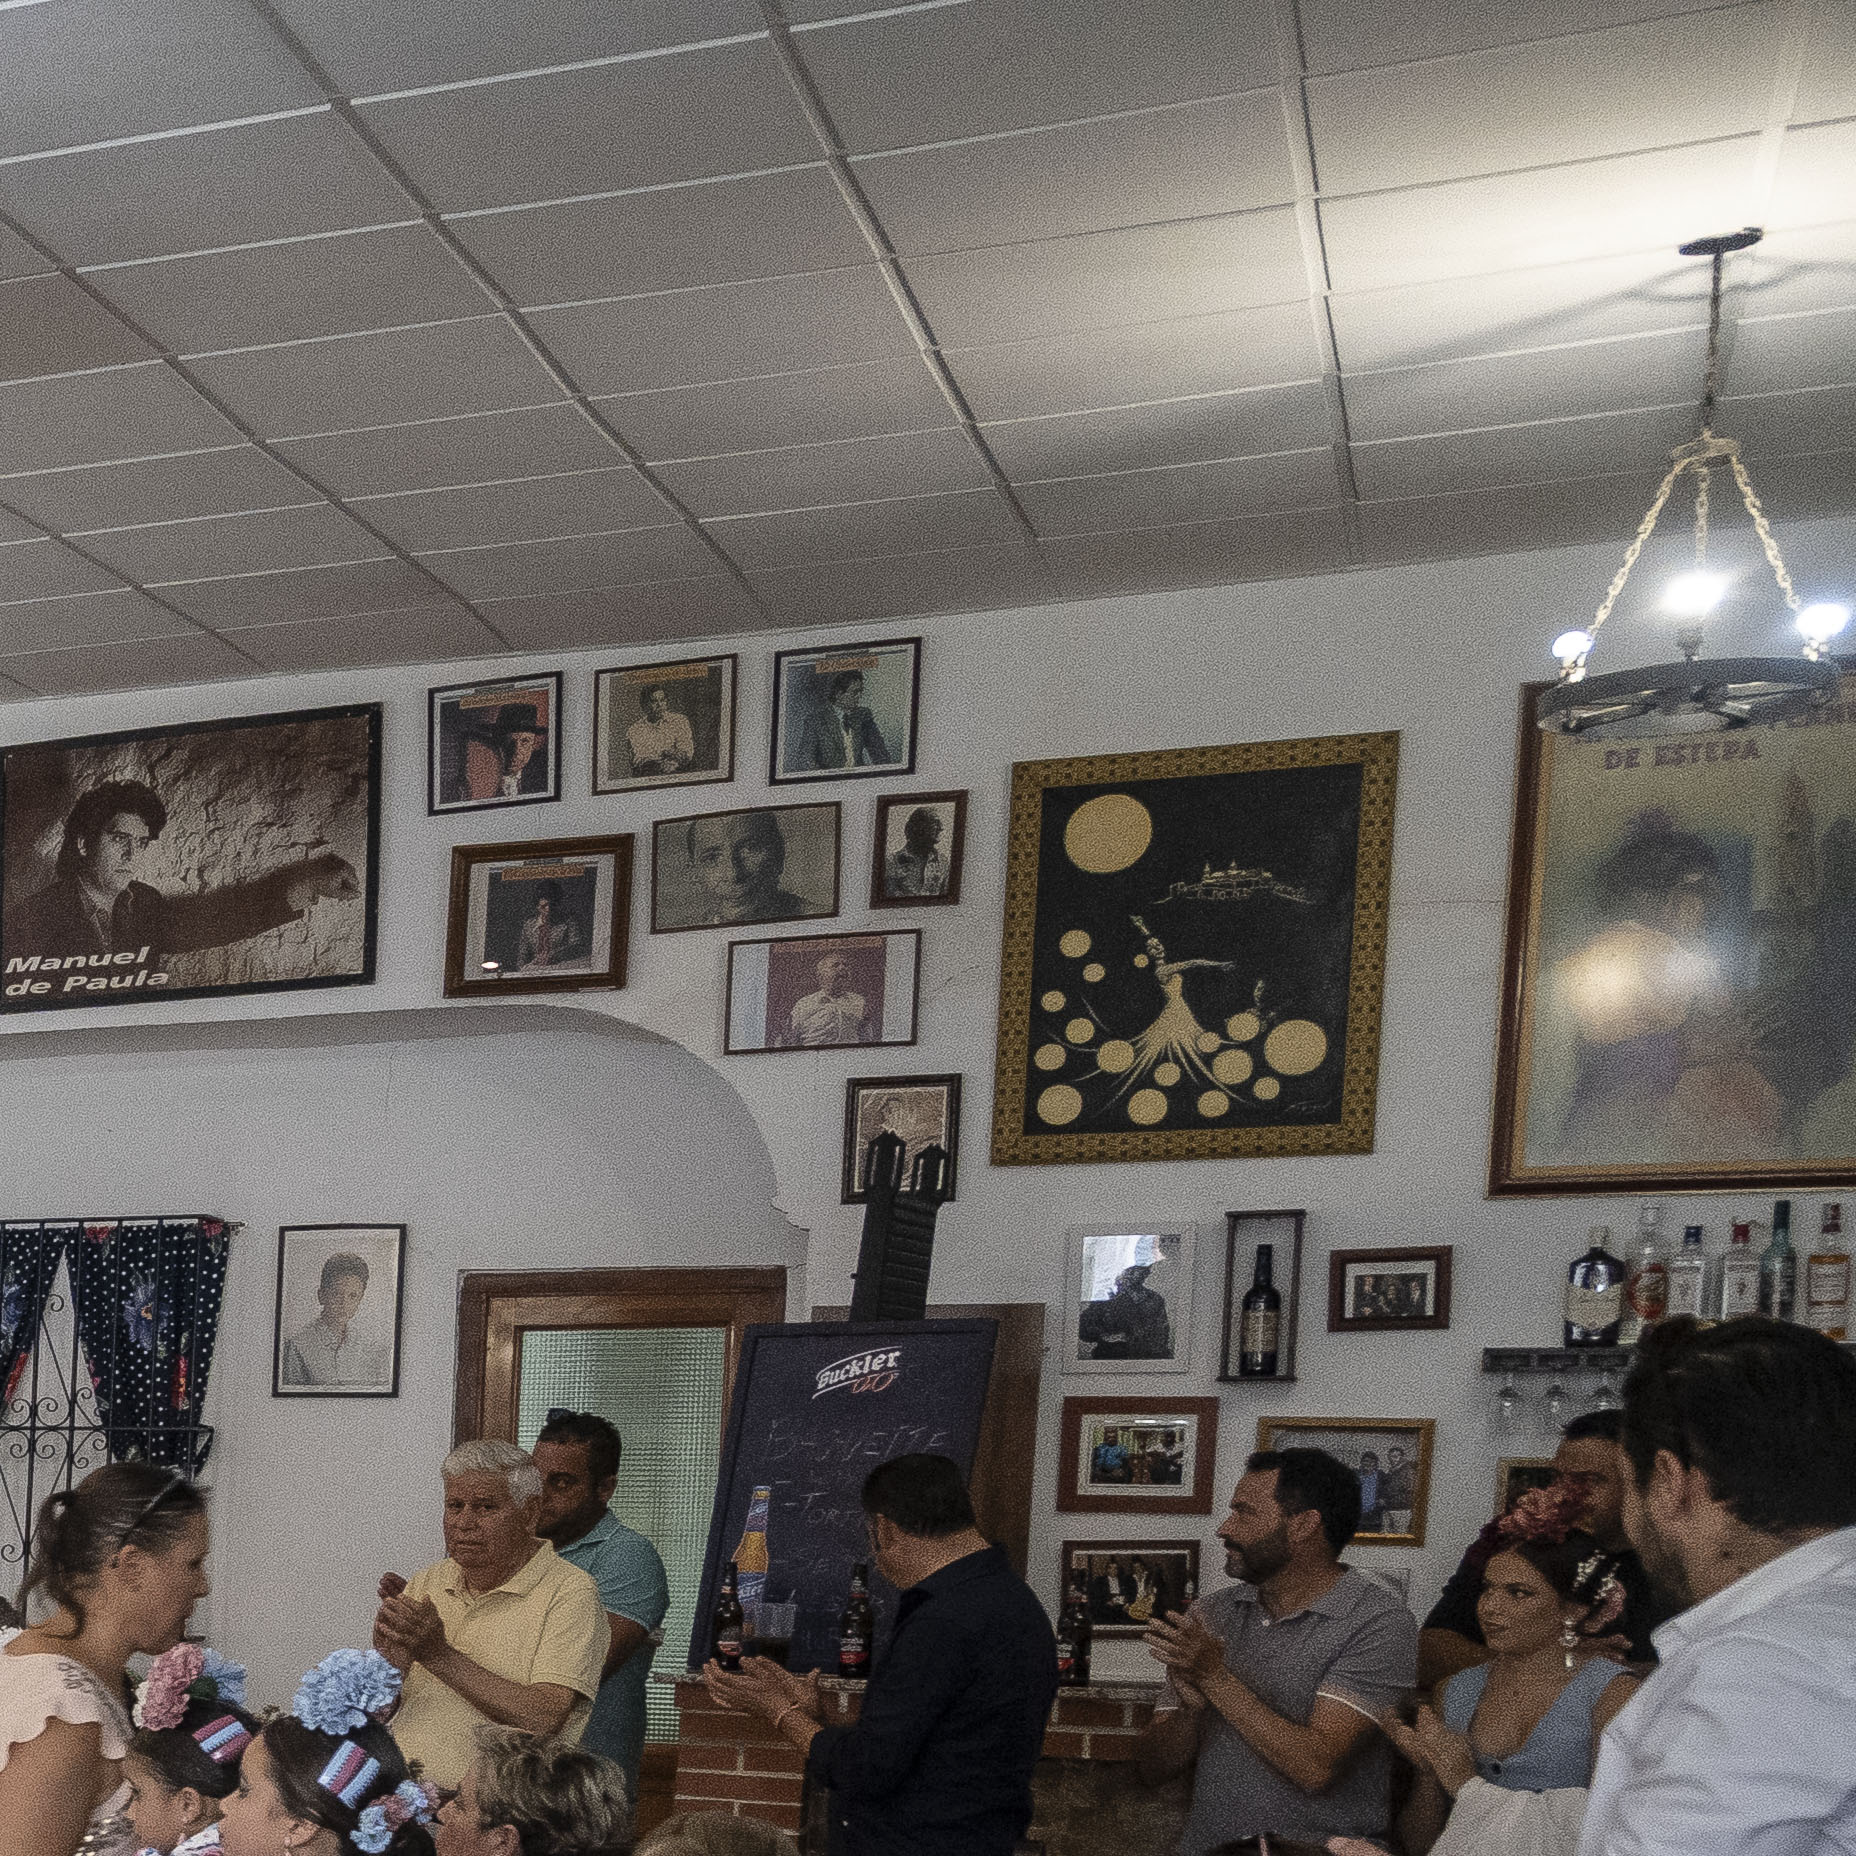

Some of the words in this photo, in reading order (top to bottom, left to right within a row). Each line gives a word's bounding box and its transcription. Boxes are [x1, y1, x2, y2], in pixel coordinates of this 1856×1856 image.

[1605, 748, 1641, 770] DE
[1654, 739, 1762, 767] ESTEPA
[5, 945, 151, 974] Manuel
[5, 978, 52, 996] de
[62, 969, 170, 993] Paula
[816, 1351, 902, 1390] Buckler
